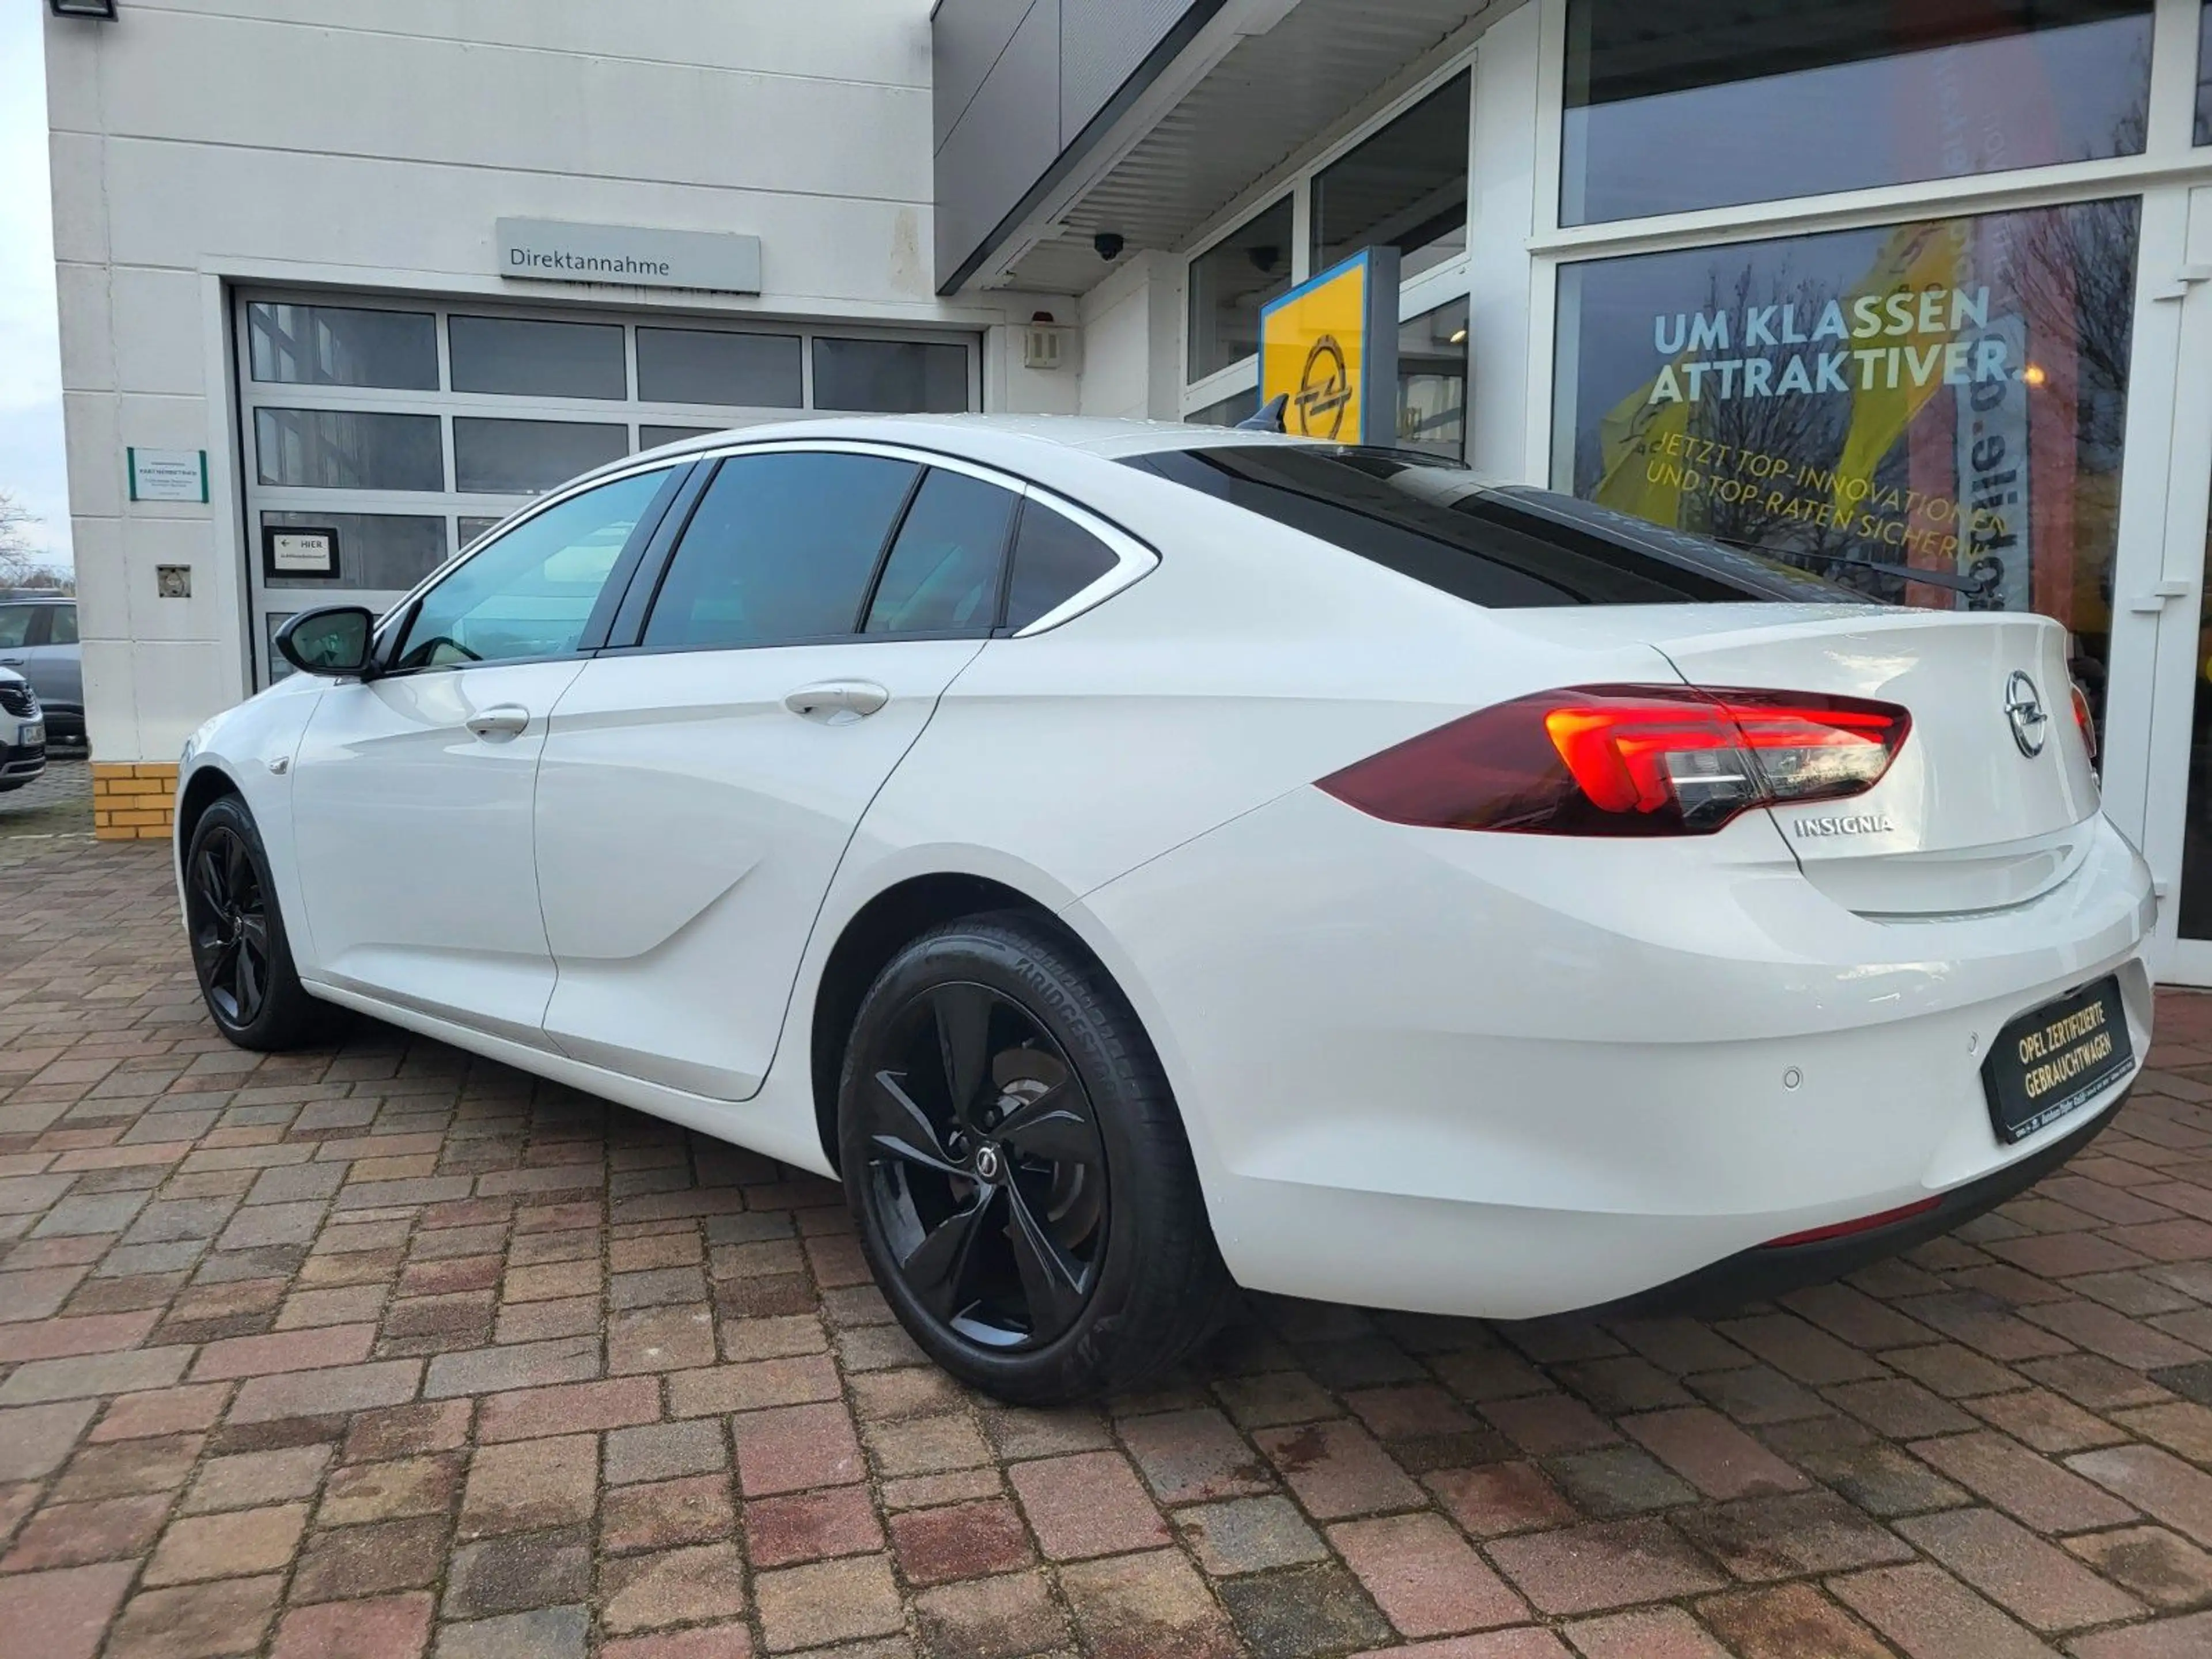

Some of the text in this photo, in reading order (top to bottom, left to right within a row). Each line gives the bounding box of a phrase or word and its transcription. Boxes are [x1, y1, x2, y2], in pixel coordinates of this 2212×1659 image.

[510, 248, 669, 276] Direktannahme
[1654, 286, 1989, 354] UM KLASSEN
[1648, 339, 2025, 403] ATTRAKTIVER.
[1657, 431, 1731, 466] JETZT
[1646, 462, 1701, 492] UND
[1709, 476, 1854, 529] TOP-RATEN
[301, 540, 323, 548] HIER
[1794, 815, 1895, 838] INSIGNIA
[2018, 1001, 2106, 1065] OPEL ZERTIFIZIERTE
[2025, 1031, 2112, 1098] GEBRAUCHTWAGEN
